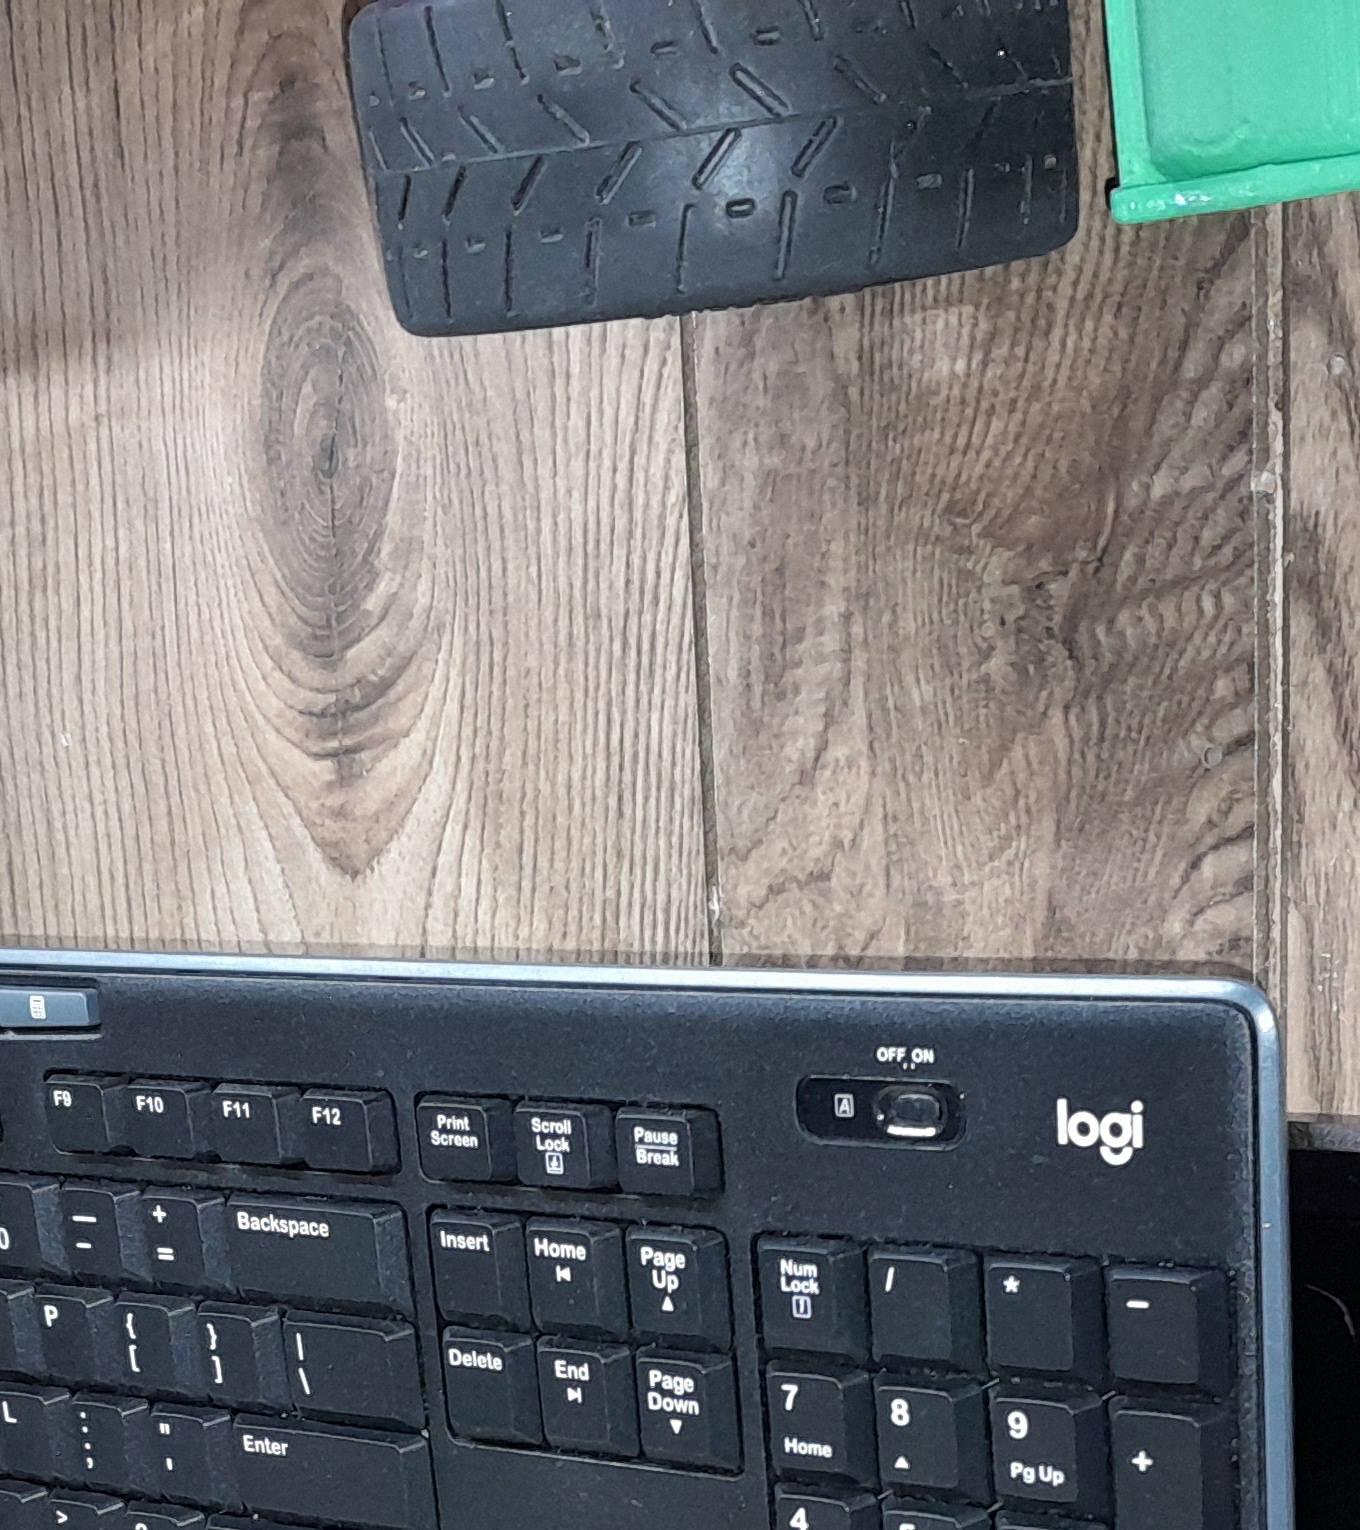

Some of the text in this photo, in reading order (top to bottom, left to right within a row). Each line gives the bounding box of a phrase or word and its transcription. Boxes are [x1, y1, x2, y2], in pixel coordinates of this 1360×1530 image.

[876, 1046, 935, 1066] OFF ON
[52, 1089, 72, 1107] F9
[135, 1095, 164, 1114] F10
[222, 1100, 250, 1118] F11
[312, 1106, 342, 1126] F12
[436, 1114, 470, 1131] Print
[530, 1117, 572, 1135] Scroll
[430, 1130, 479, 1148] Screen
[633, 1126, 678, 1146] Pause
[1056, 1098, 1144, 1166] logi
[535, 1135, 570, 1153] Lock
[635, 1149, 680, 1167] Break
[236, 1211, 330, 1238] Backspace
[440, 1230, 490, 1252] Insert
[533, 1237, 587, 1261] Home
[640, 1246, 686, 1272] Page
[780, 1258, 818, 1279] Num
[651, 1268, 680, 1294] Up
[780, 1275, 820, 1297] Lock
[43, 1304, 59, 1328] P
[448, 1348, 503, 1371] Delete
[554, 1359, 590, 1381] End
[647, 1369, 695, 1396] Page
[647, 1390, 700, 1416] Down
[781, 1383, 799, 1411] 7
[1, 1400, 18, 1424] L
[890, 1398, 910, 1427] 8
[1007, 1410, 1028, 1439] 9
[242, 1434, 289, 1456] Enter
[784, 1436, 833, 1458] Home
[1010, 1461, 1065, 1487] Pg Up
